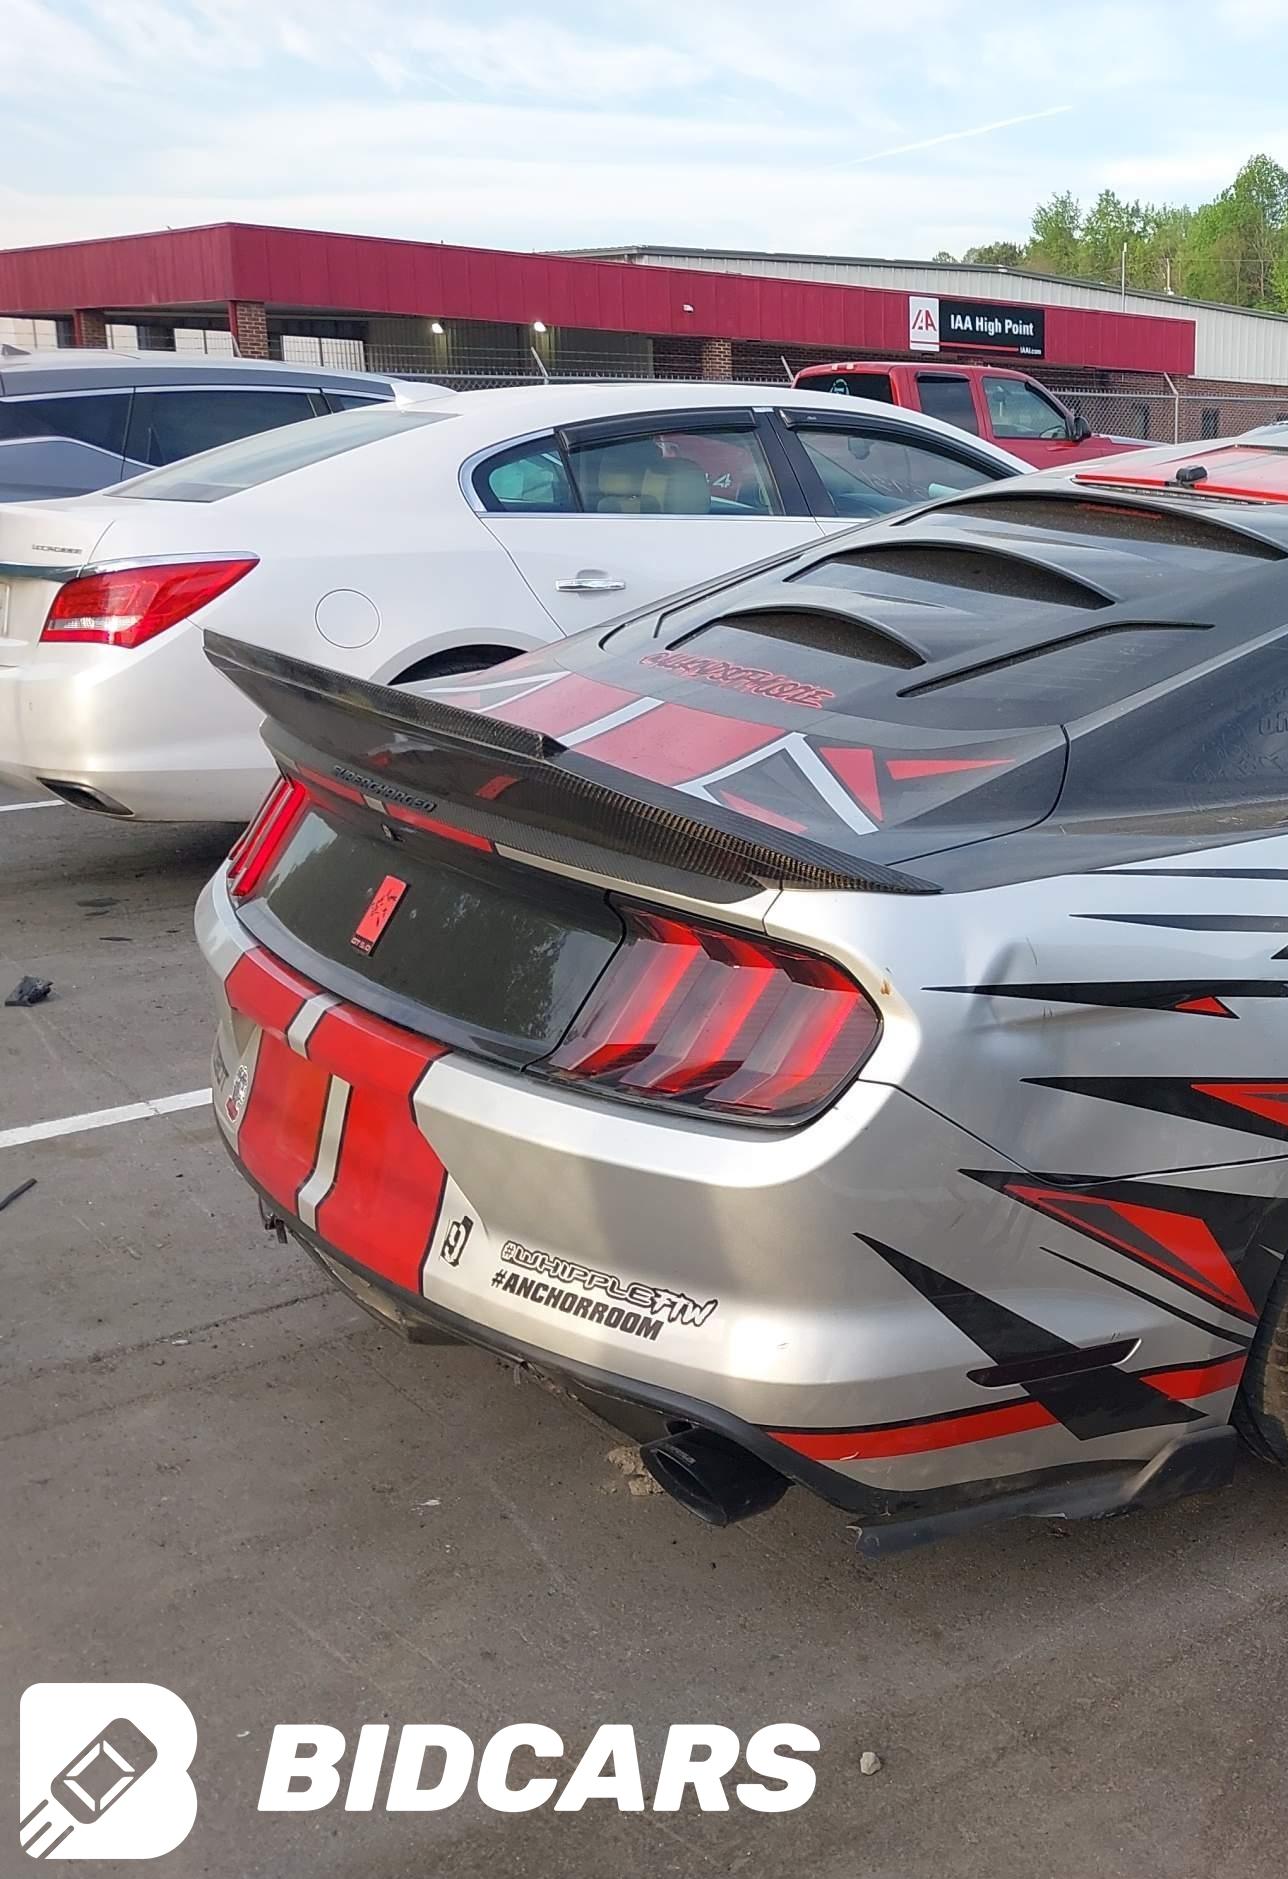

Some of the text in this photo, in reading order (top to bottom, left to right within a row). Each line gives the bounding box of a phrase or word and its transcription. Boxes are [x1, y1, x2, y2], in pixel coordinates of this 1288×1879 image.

[950, 314, 1034, 336] IAA High Point
[490, 1268, 665, 1342] #ANCHORROOM
